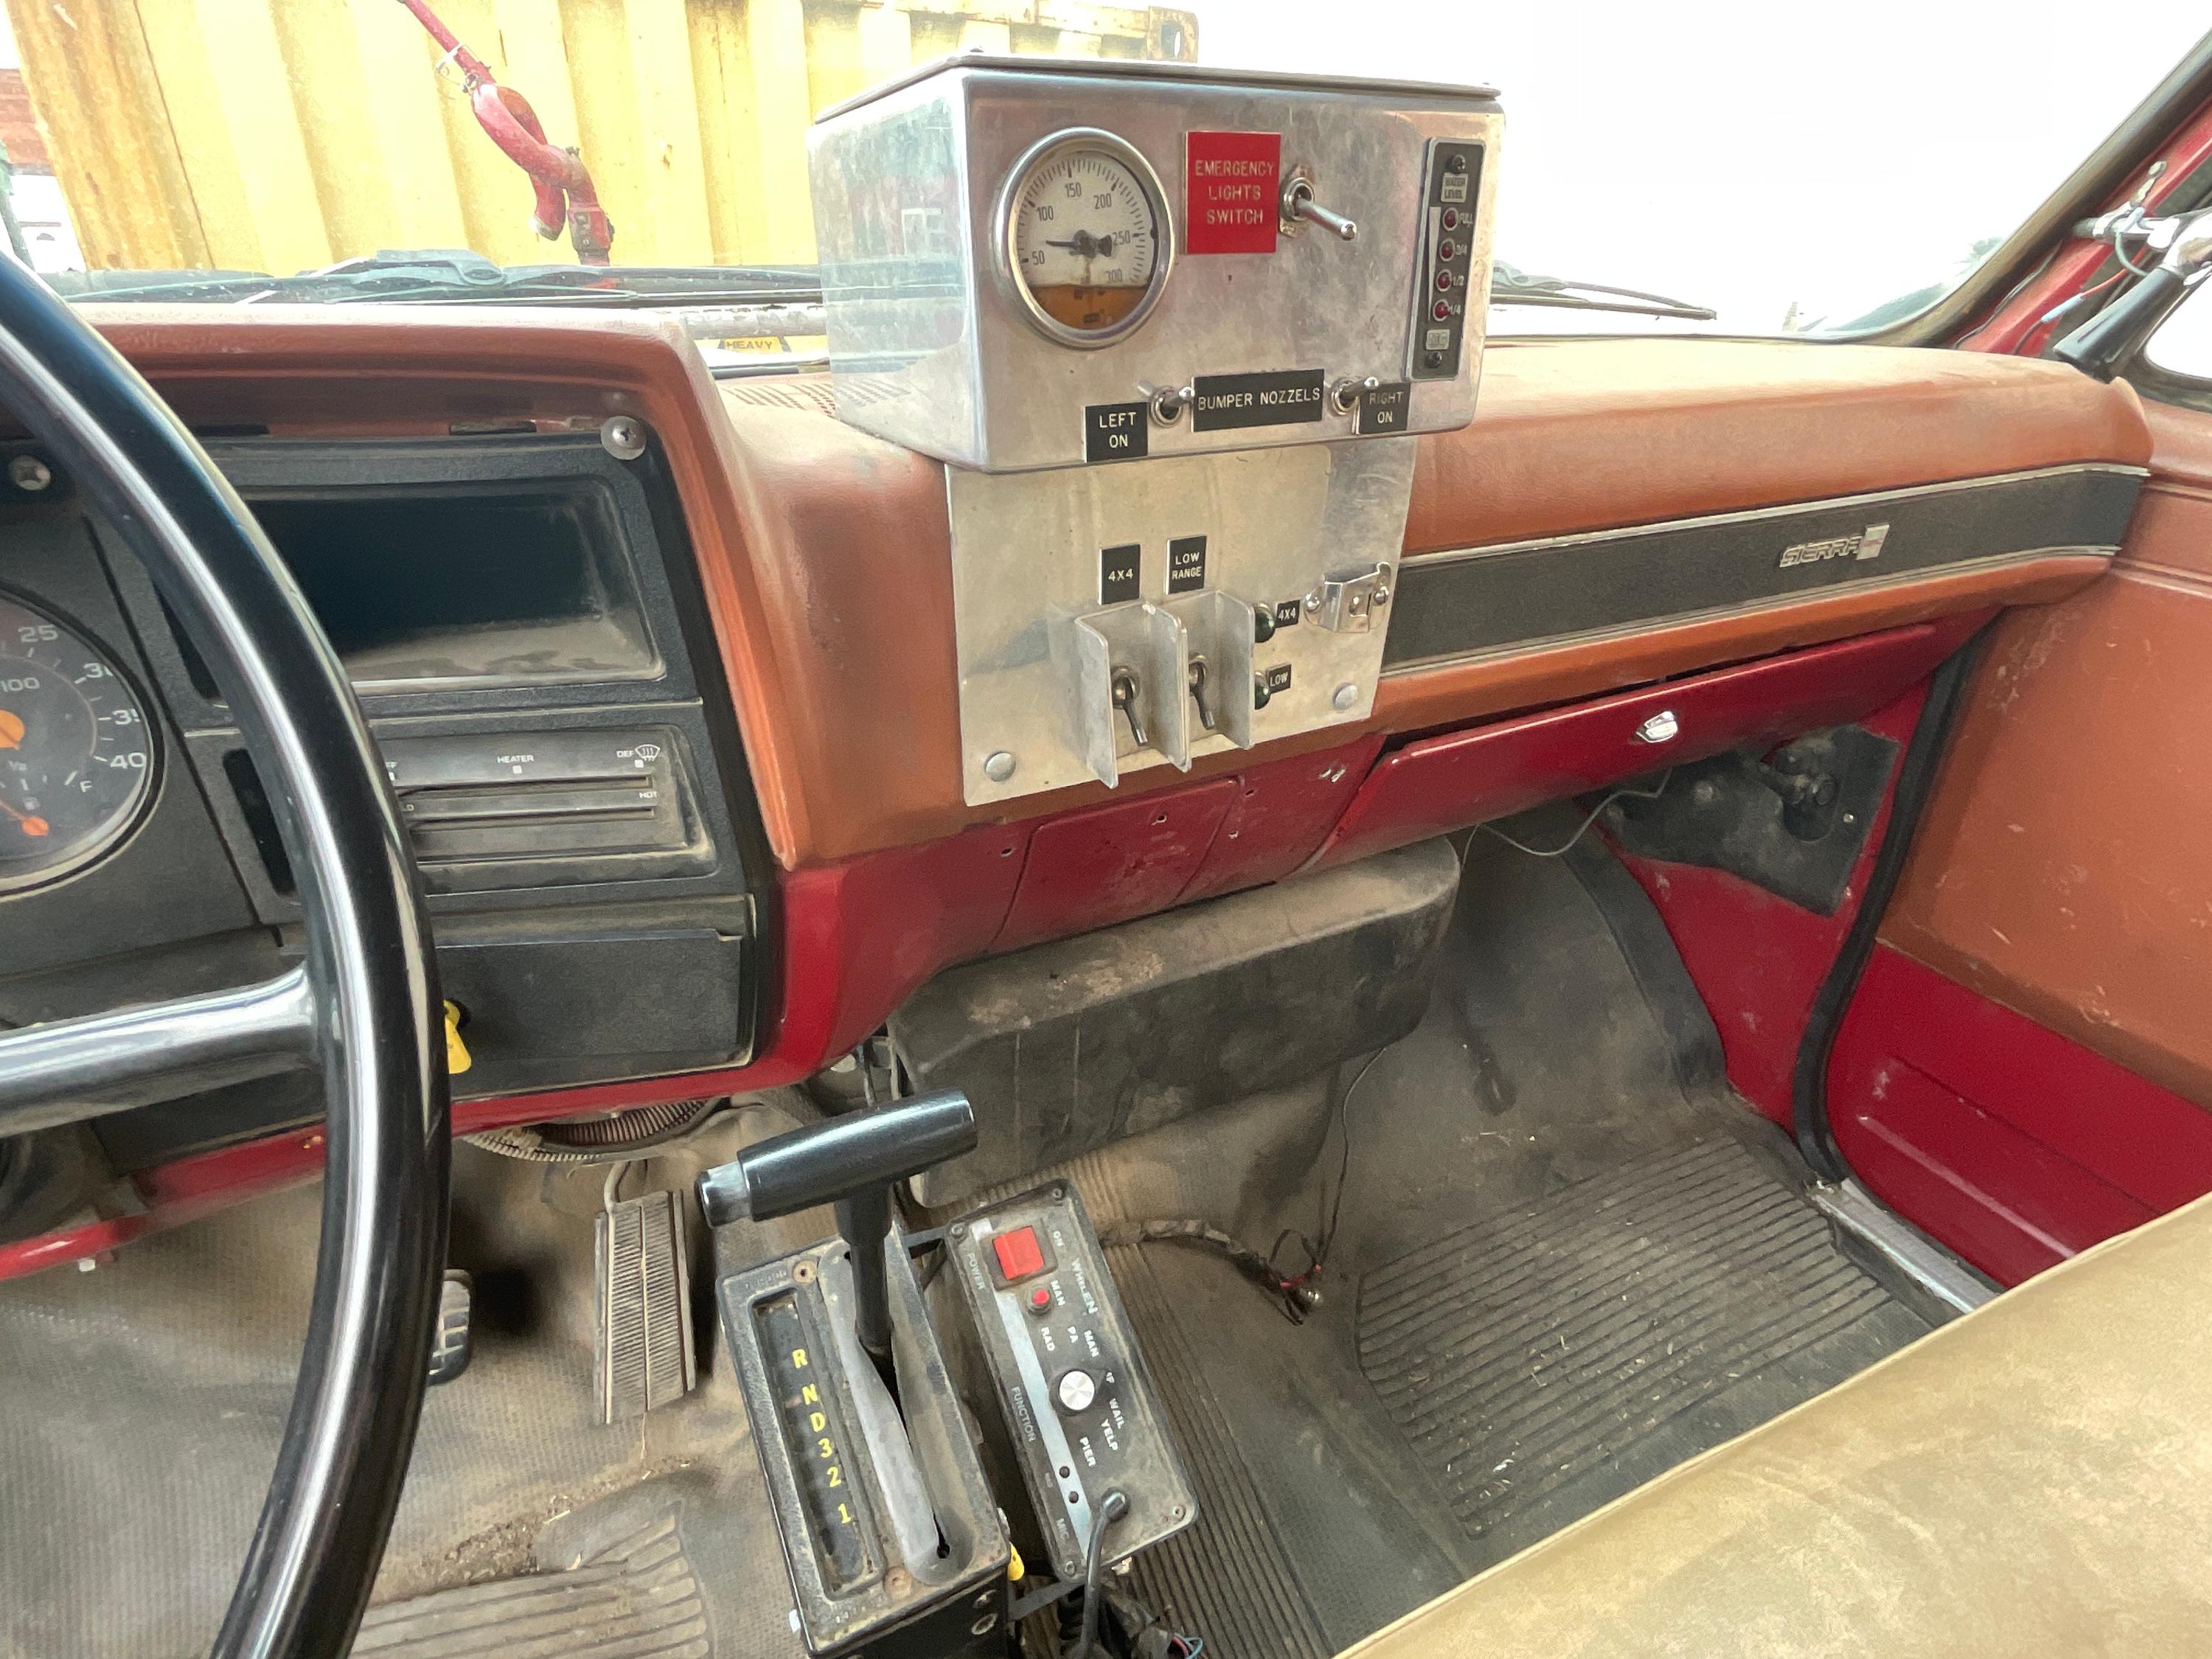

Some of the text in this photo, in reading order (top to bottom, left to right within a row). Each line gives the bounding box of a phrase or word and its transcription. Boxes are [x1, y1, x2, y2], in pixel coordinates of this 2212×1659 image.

[1195, 160, 1274, 177] EMERGENCY
[1065, 182, 1082, 198] 150
[1208, 185, 1261, 201] LIGHTS
[1093, 193, 1112, 209] 200
[1037, 206, 1054, 221] 100
[1206, 209, 1263, 224] SWITCH
[1113, 230, 1131, 246] 250
[1032, 251, 1046, 265] 50
[1106, 268, 1123, 283] 300
[726, 340, 773, 349] HEAVY
[1198, 387, 1321, 411] BUMPER NOZZELS
[1369, 392, 1404, 405] RIGHT
[1099, 411, 1137, 428] LEFT
[1377, 411, 1393, 423] ON
[1109, 435, 1128, 448] ON
[1175, 552, 1200, 565] LOW
[1779, 535, 1863, 568] SIERRA
[1108, 568, 1133, 582] 4X4
[1171, 566, 1202, 580] RANGE
[1279, 607, 1296, 620] 4X4
[18, 625, 58, 643] 25
[1, 677, 40, 692] 100
[1270, 672, 1288, 687] LOW
[111, 752, 147, 769] 40
[497, 754, 534, 763] HEATER
[80, 780, 92, 793] F
[639, 790, 658, 799] HOT
[967, 1253, 985, 1290] POWER
[1051, 1280, 1066, 1306] MAN
[1071, 1257, 1098, 1314] WHELEN
[1041, 1327, 1055, 1352] RAD
[1068, 1326, 1079, 1343] PA
[1084, 1329, 1099, 1357] MAN
[793, 1349, 808, 1368] R
[802, 1384, 818, 1405] N
[1012, 1386, 1037, 1442] FUNCTION
[1109, 1398, 1124, 1429] WAIL
[810, 1413, 826, 1432] D
[1101, 1419, 1119, 1451] YELP
[818, 1439, 833, 1458] 3
[1079, 1437, 1097, 1467] PIER
[827, 1467, 841, 1487] 2
[838, 1503, 851, 1523] 1
[1056, 1517, 1069, 1541] MIC
